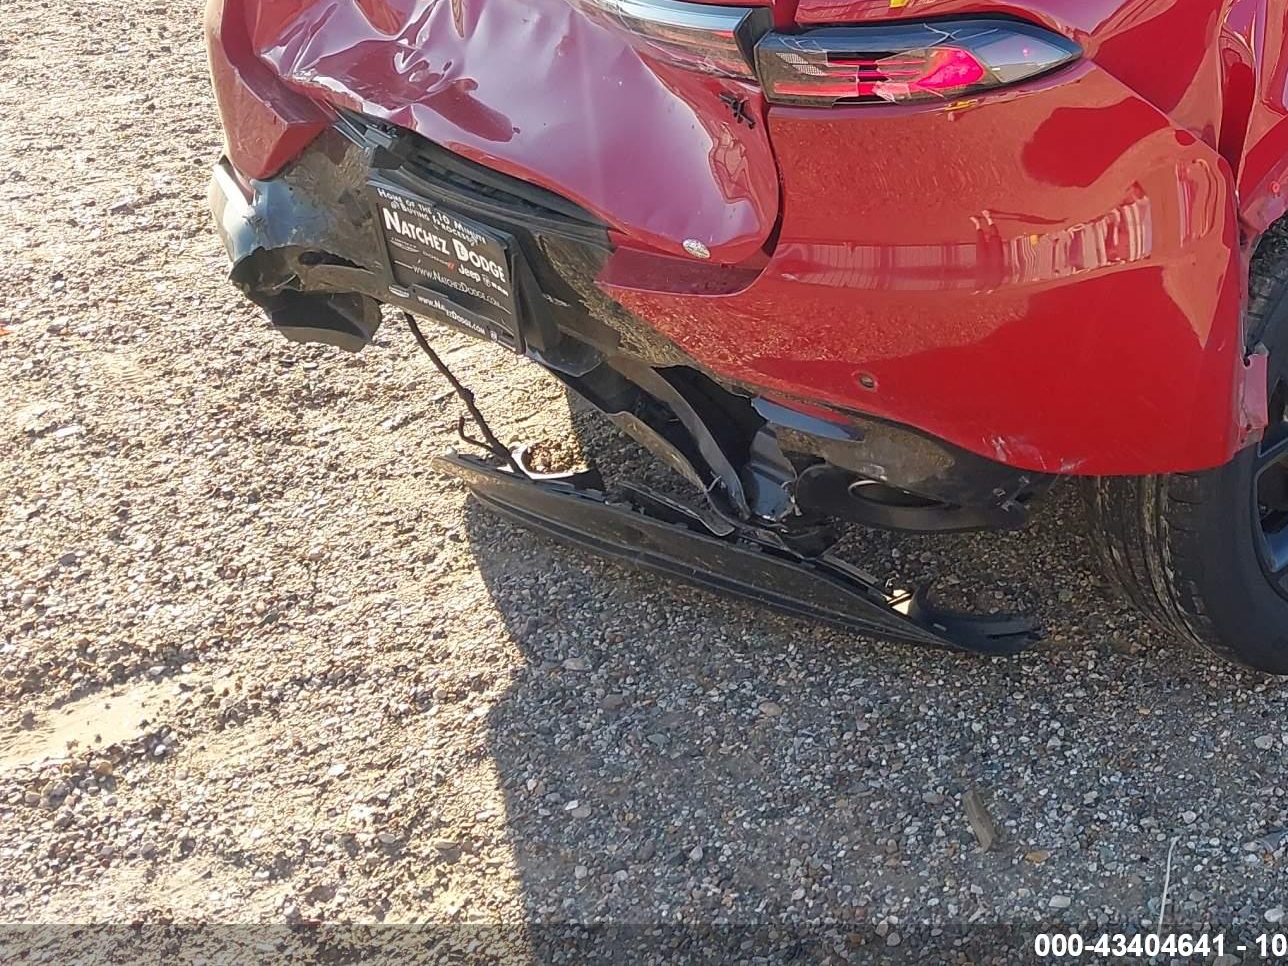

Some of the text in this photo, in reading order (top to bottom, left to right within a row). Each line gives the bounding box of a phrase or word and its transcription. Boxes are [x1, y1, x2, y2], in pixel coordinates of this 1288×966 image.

[436, 211, 450, 225] 10
[382, 207, 506, 283] NATCHEZ DODGE
[458, 263, 481, 283] Jeep
